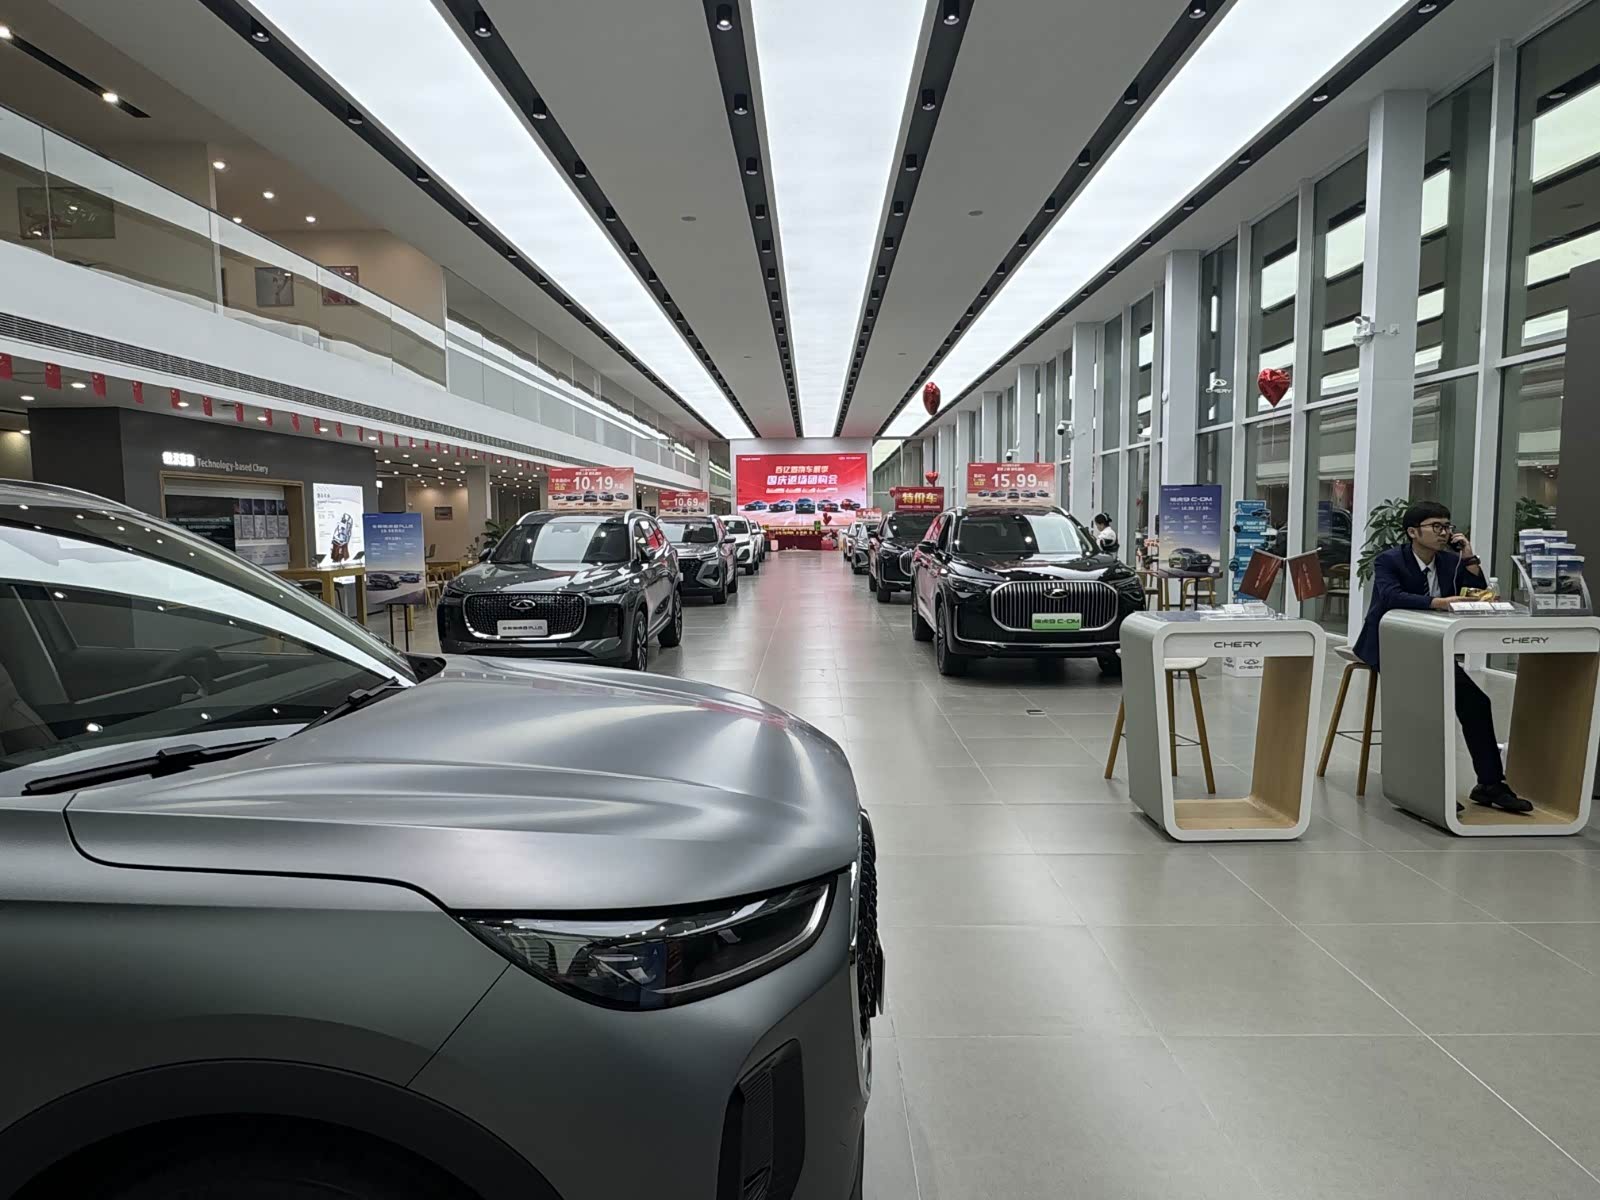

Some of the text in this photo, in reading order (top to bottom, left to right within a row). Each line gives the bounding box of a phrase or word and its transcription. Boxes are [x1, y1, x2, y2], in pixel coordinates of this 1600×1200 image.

[197, 457, 252, 472] Technology-based
[252, 463, 269, 474] Chery
[573, 476, 614, 490] 10.19
[991, 473, 1037, 488] 15.99
[674, 497, 699, 507] 10.69
[902, 492, 938, 504] 特价车
[1213, 641, 1263, 649] CHERY
[1501, 636, 1550, 645] CHERY
